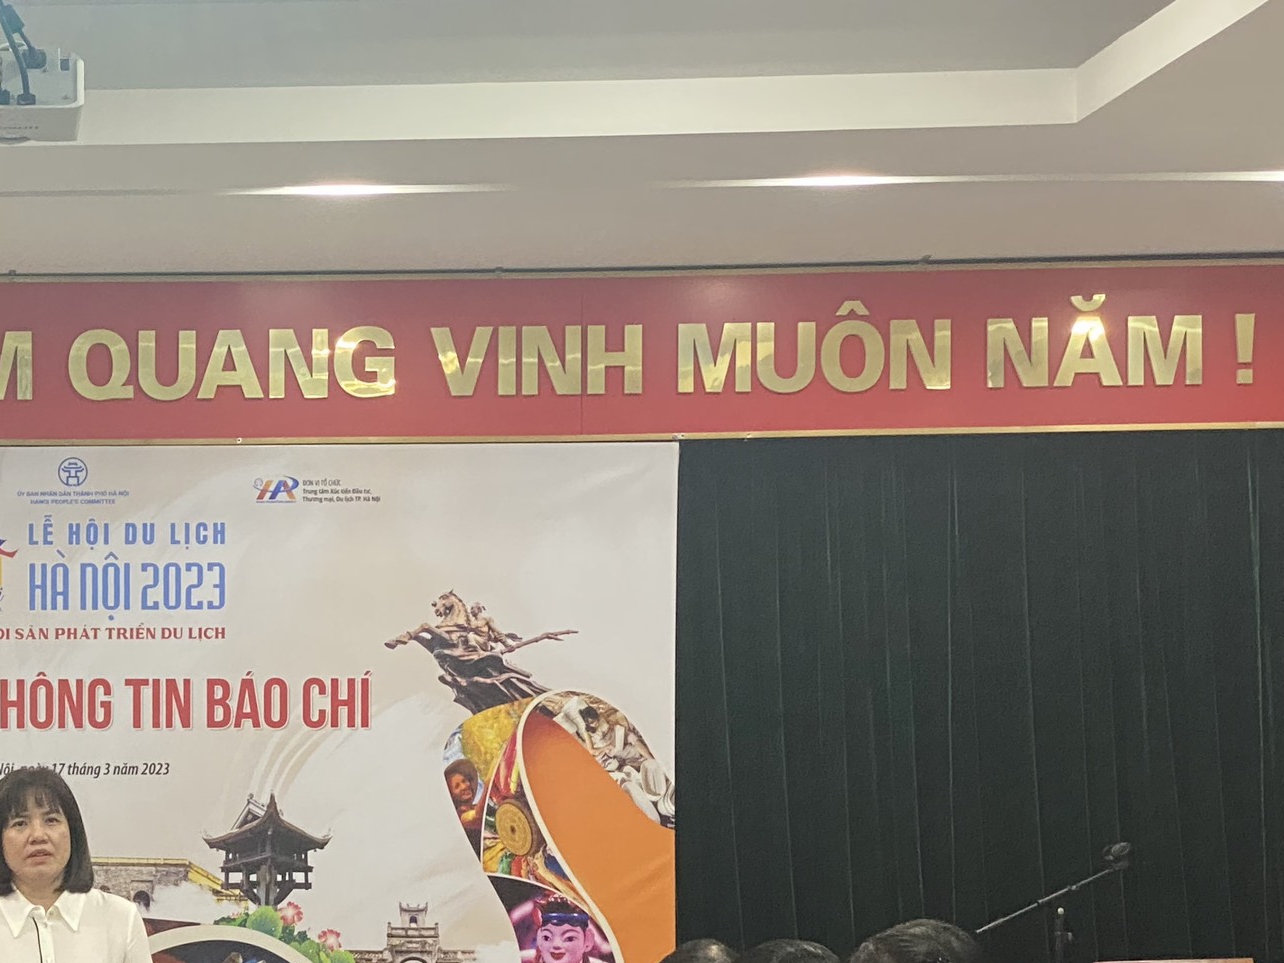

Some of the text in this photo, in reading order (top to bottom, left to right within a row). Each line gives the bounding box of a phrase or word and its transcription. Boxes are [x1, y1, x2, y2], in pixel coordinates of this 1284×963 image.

[68, 326, 397, 402] QUANG
[430, 324, 643, 397] VINH
[678, 300, 952, 394] MUÔN
[986, 293, 1203, 389] NĂM
[28, 514, 226, 550] LỄ HỘI DU LỊCH
[28, 549, 226, 621] HÀ NỘI 2023
[15, 624, 49, 640] SẢN
[55, 624, 100, 640] PHÁT
[105, 622, 157, 640] TRIỂN
[161, 627, 183, 640] DU
[188, 627, 226, 642] LỊCH
[124, 676, 192, 730] TIN
[206, 670, 290, 730] BÁO
[301, 669, 374, 730] CHÍ
[52, 763, 66, 776] 17
[67, 762, 100, 779] tháng
[103, 763, 110, 775] 3
[113, 762, 139, 775] năm
[141, 762, 170, 775] 2023
